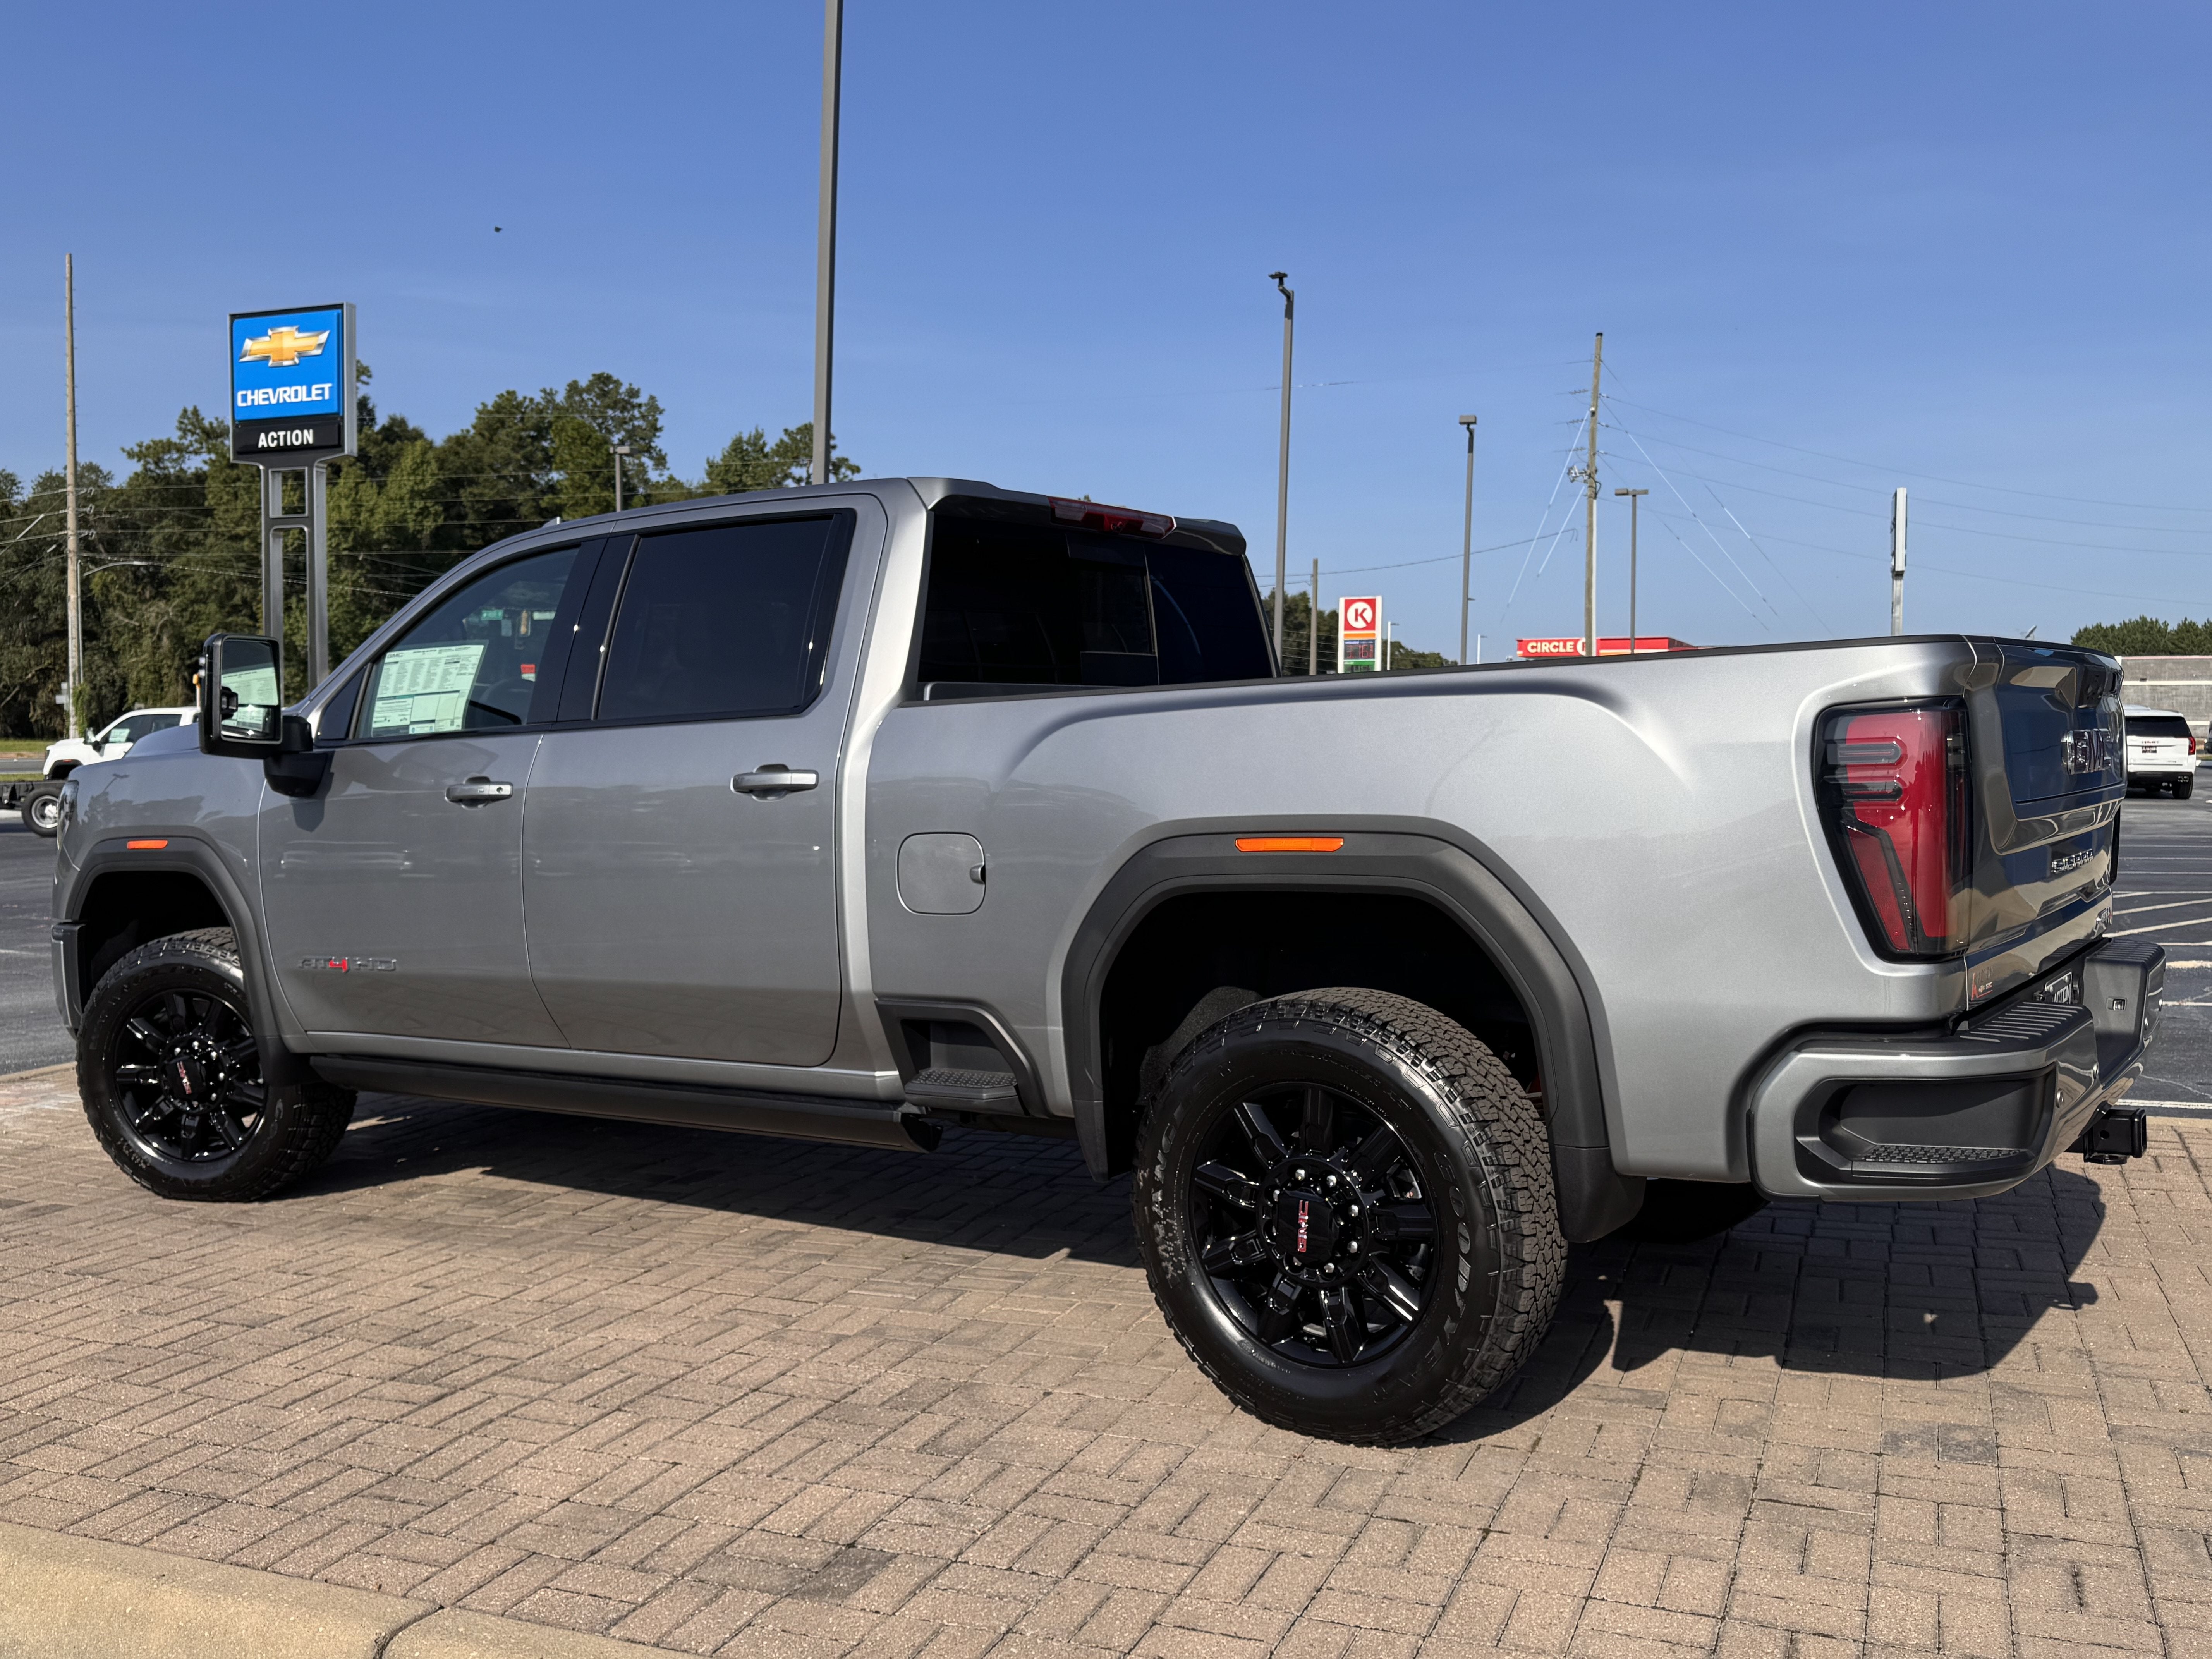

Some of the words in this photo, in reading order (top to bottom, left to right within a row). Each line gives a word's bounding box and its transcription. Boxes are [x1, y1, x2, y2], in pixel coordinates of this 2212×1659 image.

[237, 383, 333, 407] CHEVROLET
[258, 429, 314, 448] ACTION
[1355, 608, 1370, 625] K
[1527, 641, 1574, 653] CIRCLE
[1297, 1199, 1309, 1253] GMC
